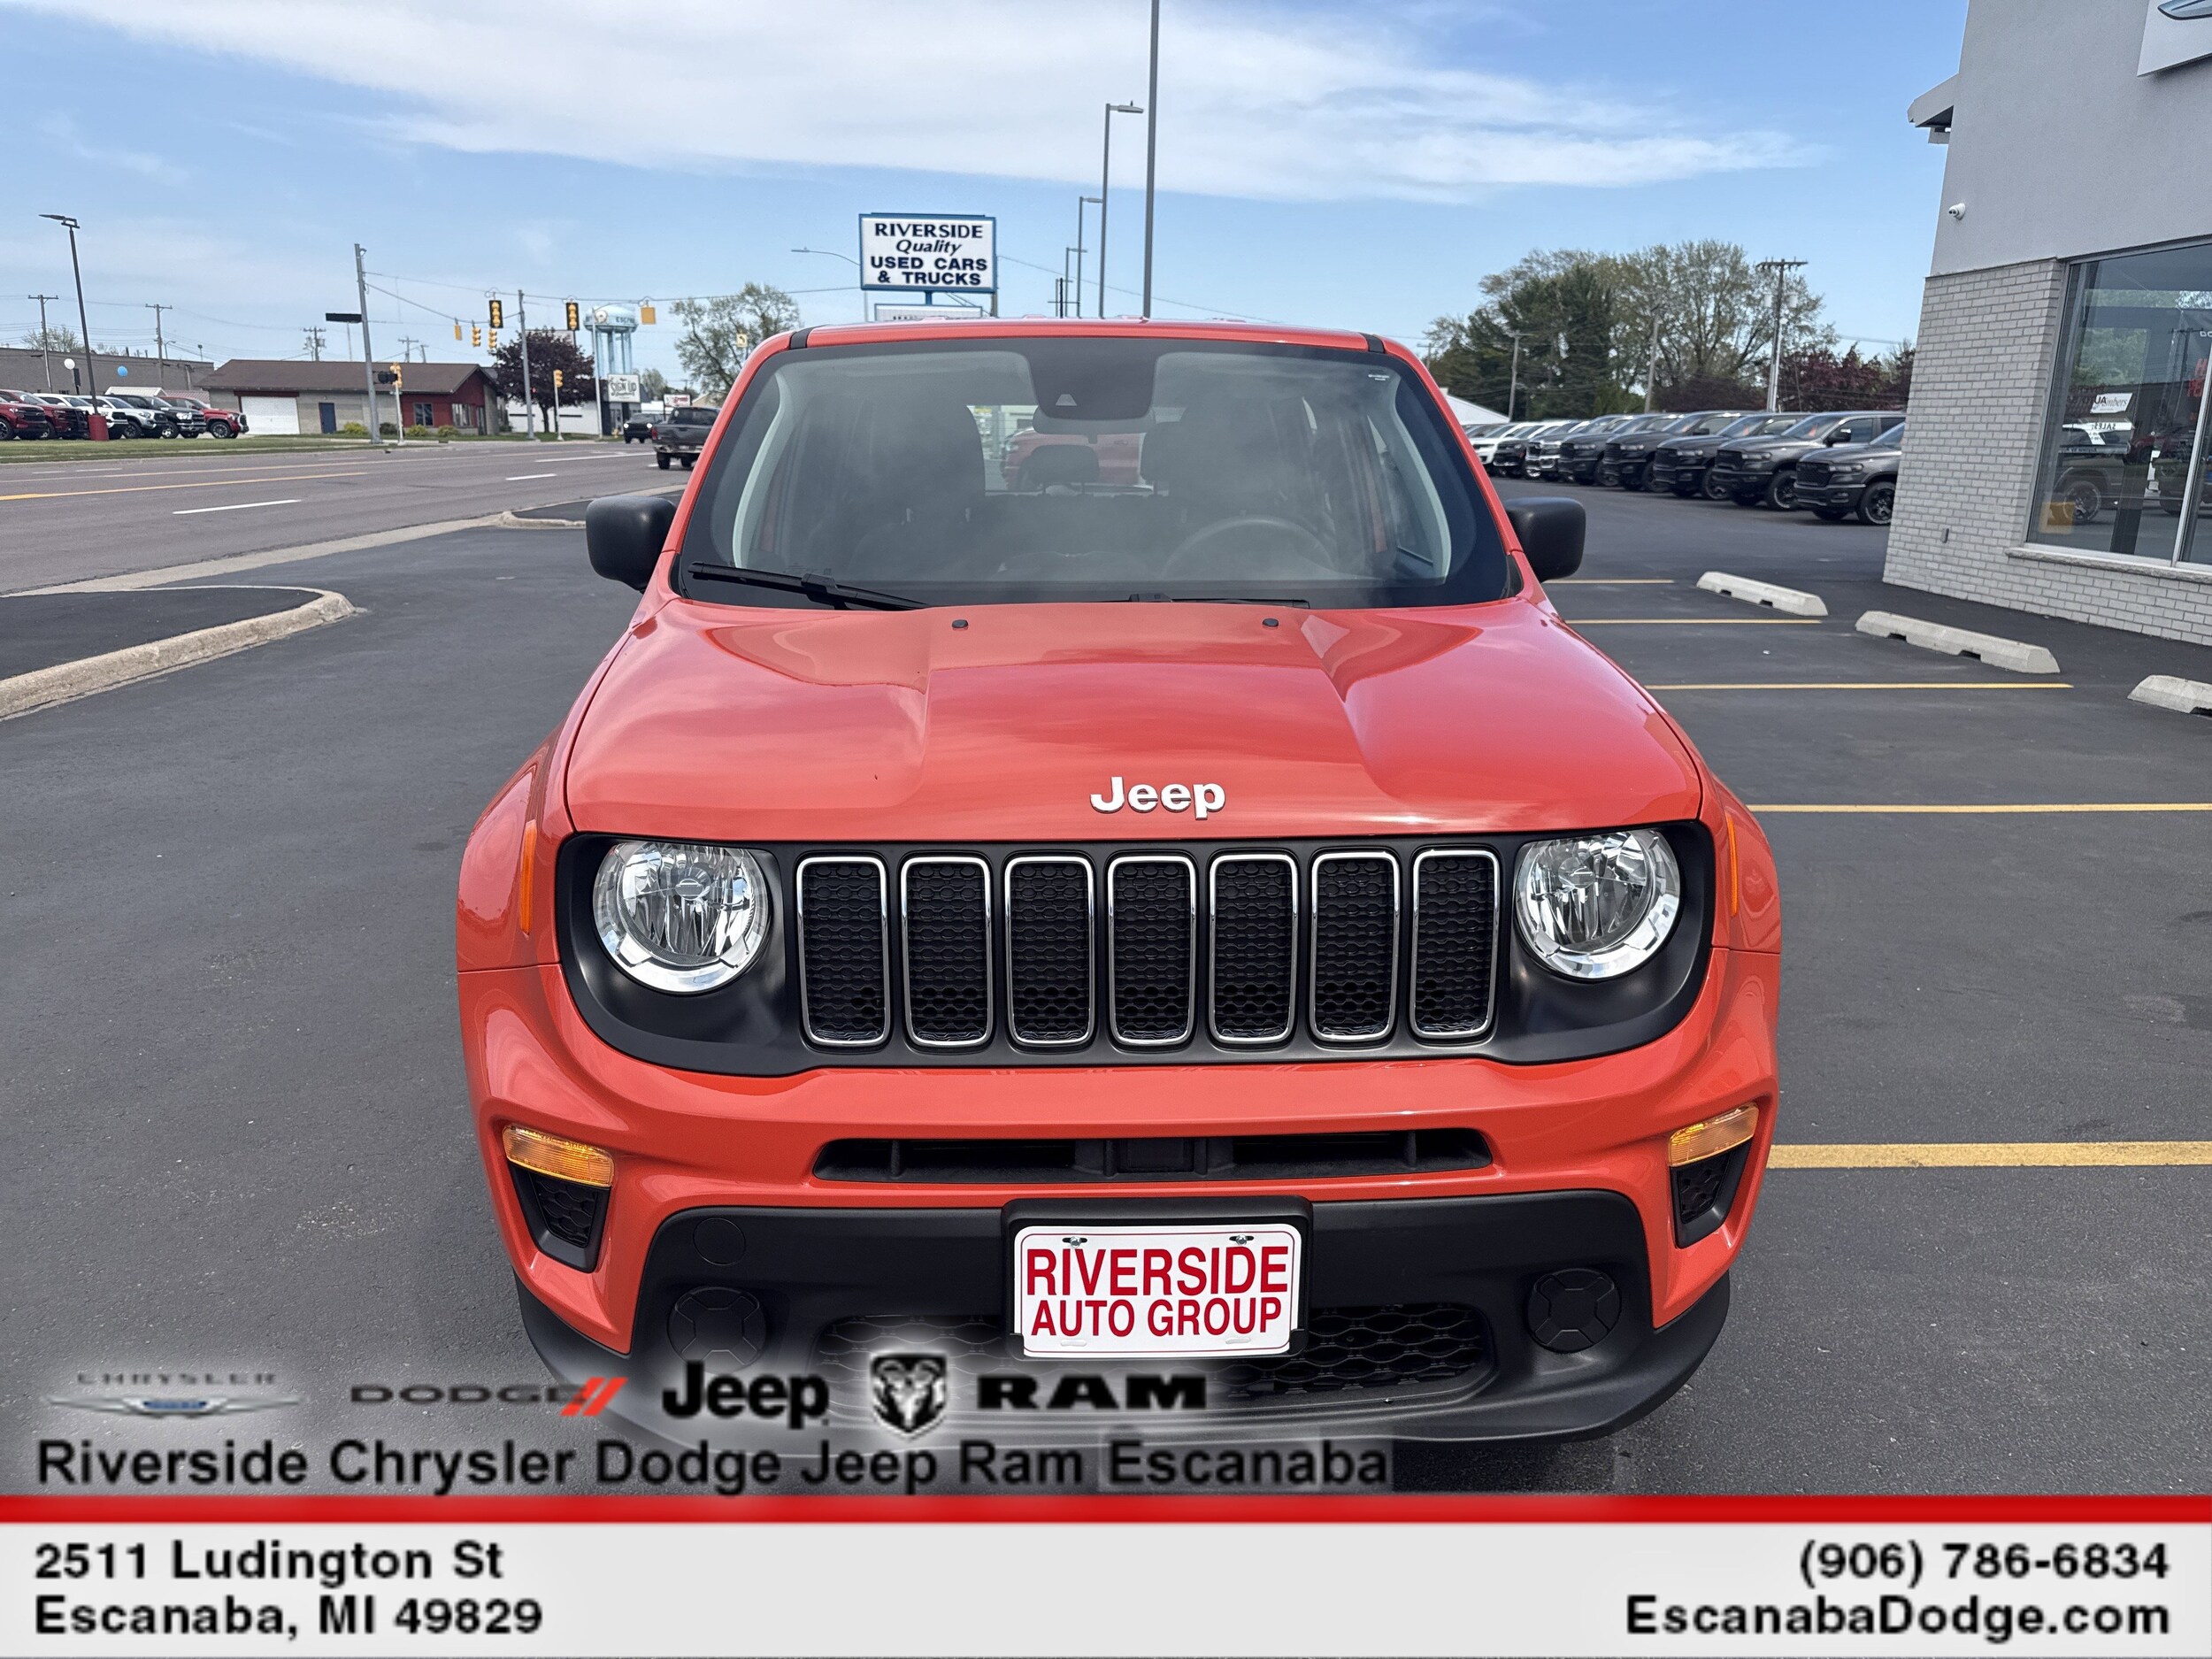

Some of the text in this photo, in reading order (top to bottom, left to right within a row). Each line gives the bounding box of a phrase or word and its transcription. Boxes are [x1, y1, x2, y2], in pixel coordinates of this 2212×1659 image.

[875, 223, 983, 238] RIVERSIDE
[896, 239, 962, 256] Quality
[871, 256, 987, 271] USED CARS
[878, 270, 981, 286] & TRUCKS
[1090, 776, 1226, 820] Jeep
[1026, 1246, 1289, 1296] RIVERSIDE
[1031, 1297, 1282, 1337] AUTO GROUP
